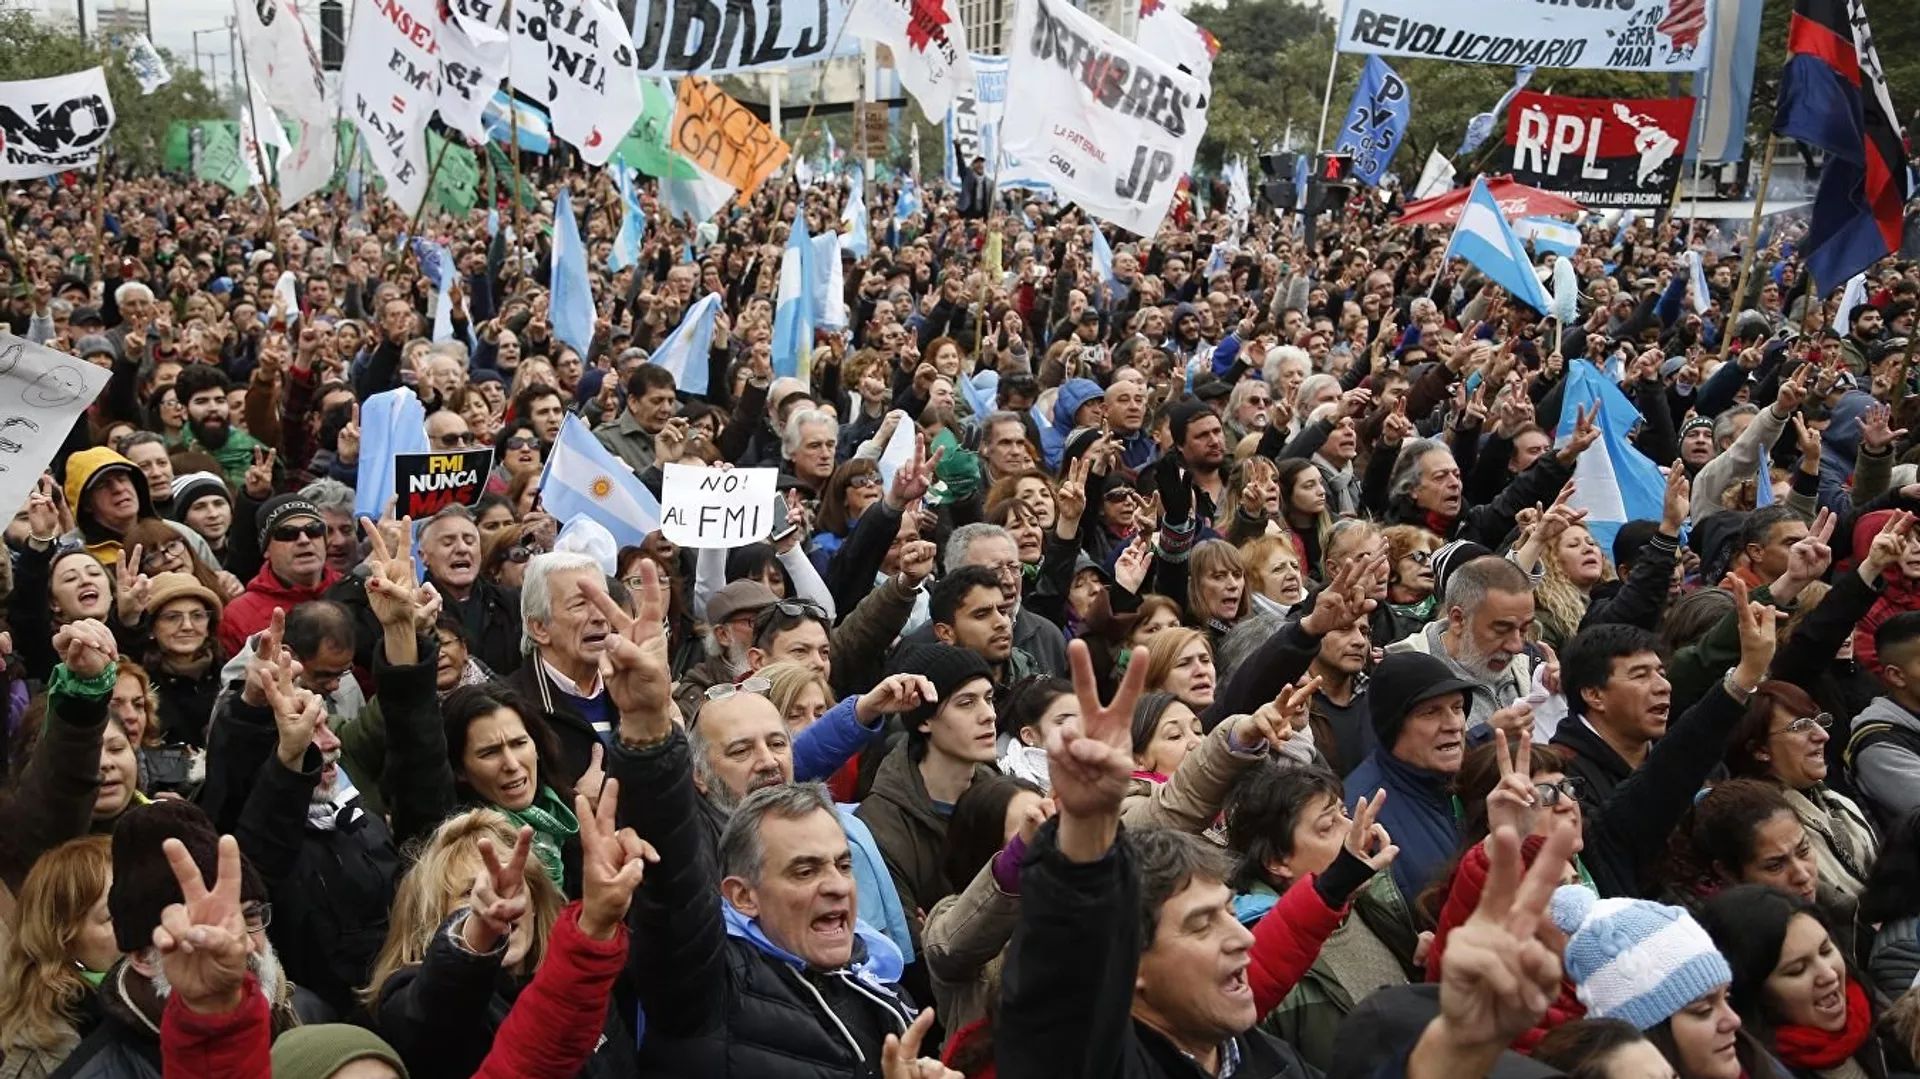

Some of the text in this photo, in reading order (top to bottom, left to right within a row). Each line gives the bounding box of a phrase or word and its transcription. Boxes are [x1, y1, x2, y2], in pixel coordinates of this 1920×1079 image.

[1350, 8, 1588, 67] REVOLUCIONARIO
[1513, 107, 1609, 180] RPL
[1115, 145, 1175, 203] JP
[409, 469, 478, 493] NUNCA
[429, 455, 464, 475] FMI
[663, 505, 759, 539] AL FMI
